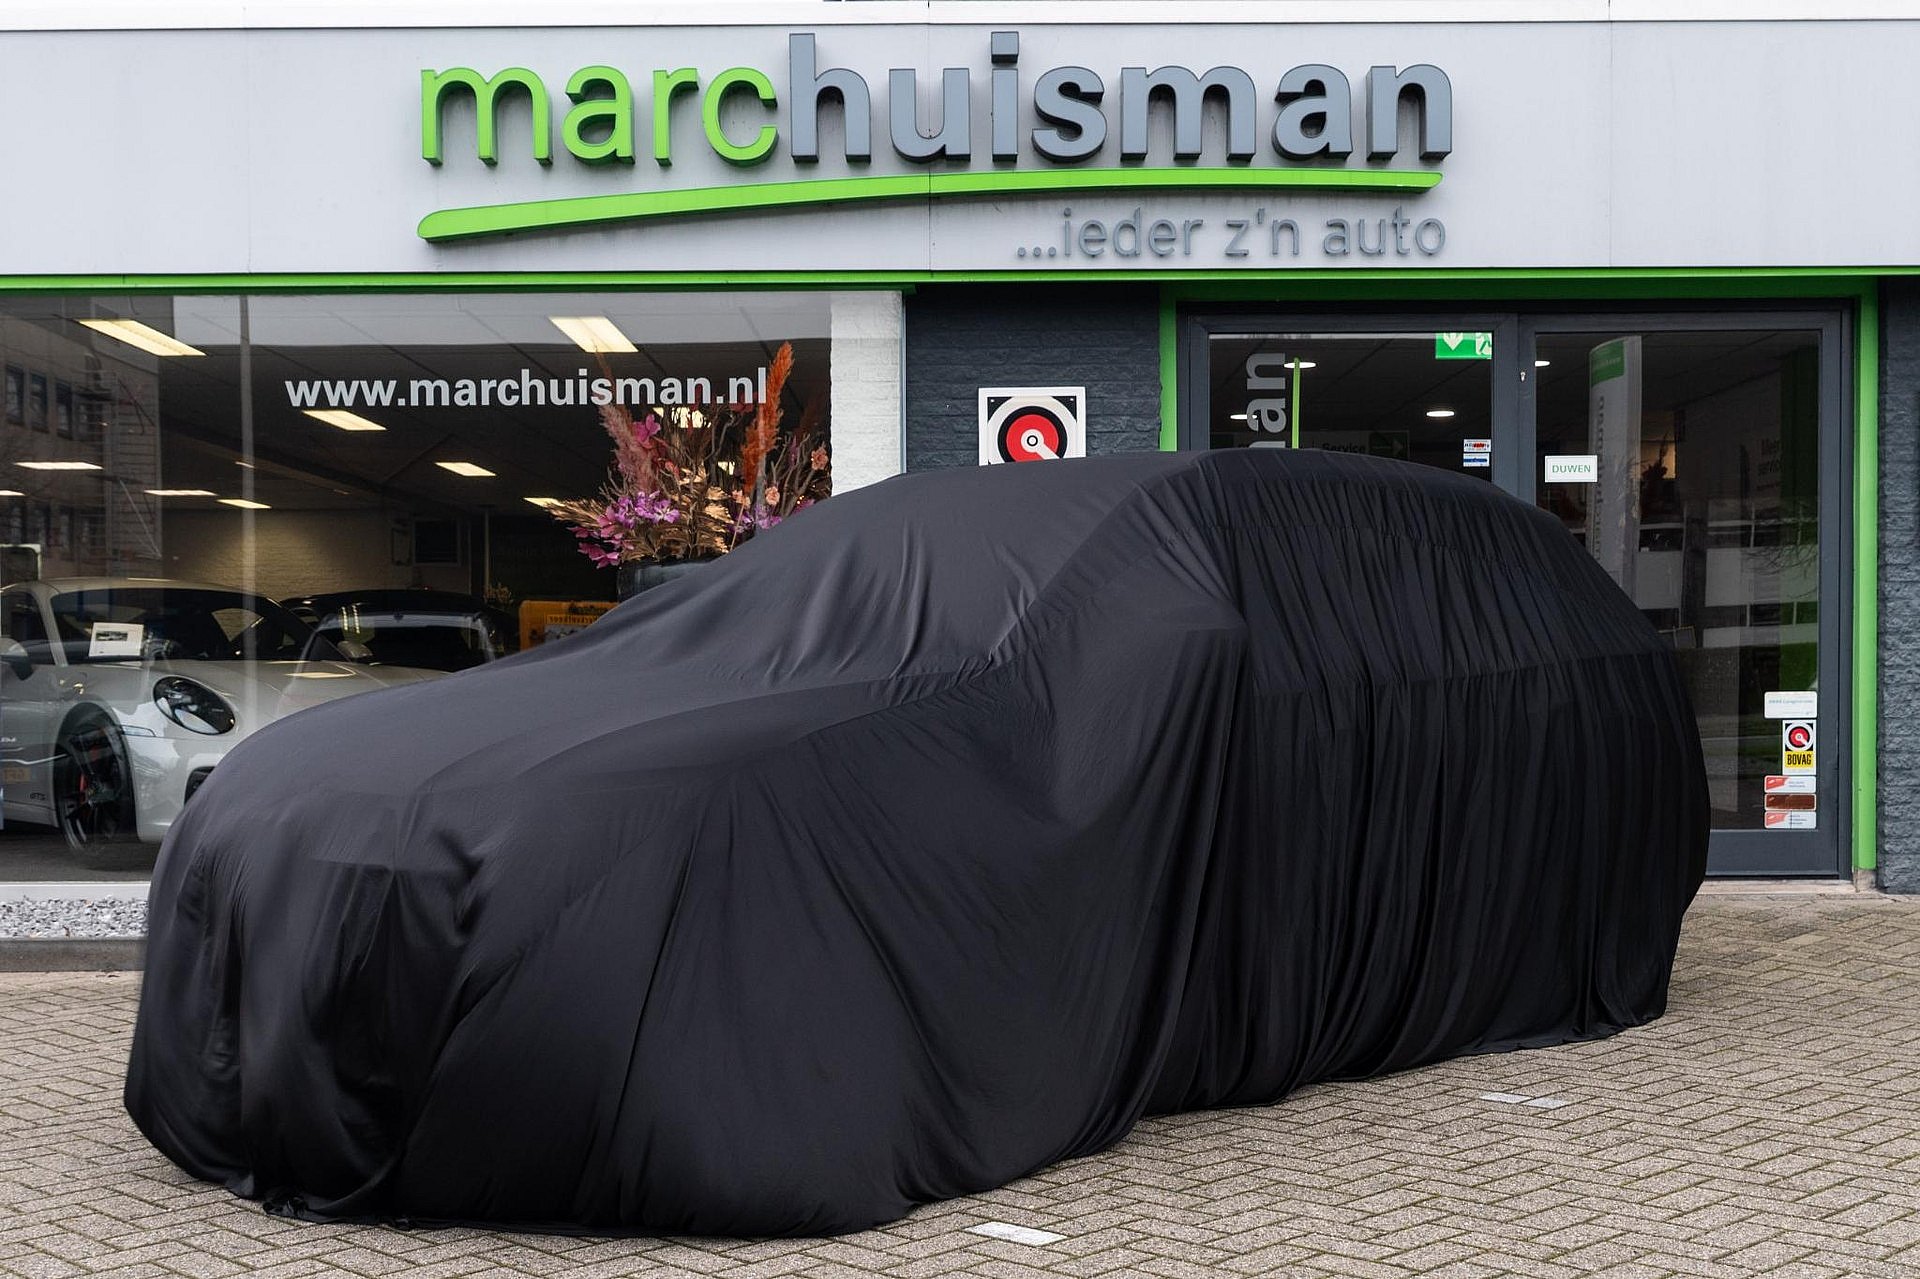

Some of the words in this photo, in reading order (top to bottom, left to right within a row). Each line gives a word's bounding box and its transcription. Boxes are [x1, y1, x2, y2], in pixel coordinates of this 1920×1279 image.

[420, 32, 1452, 165] marchuisman
[1224, 208, 1300, 257] z'n
[1322, 208, 1447, 257] auto
[285, 367, 767, 407] www.marchuisman.nl
[1246, 353, 1287, 448] an
[1552, 464, 1591, 473] DUWEN
[1787, 754, 1812, 766] BOVAG
